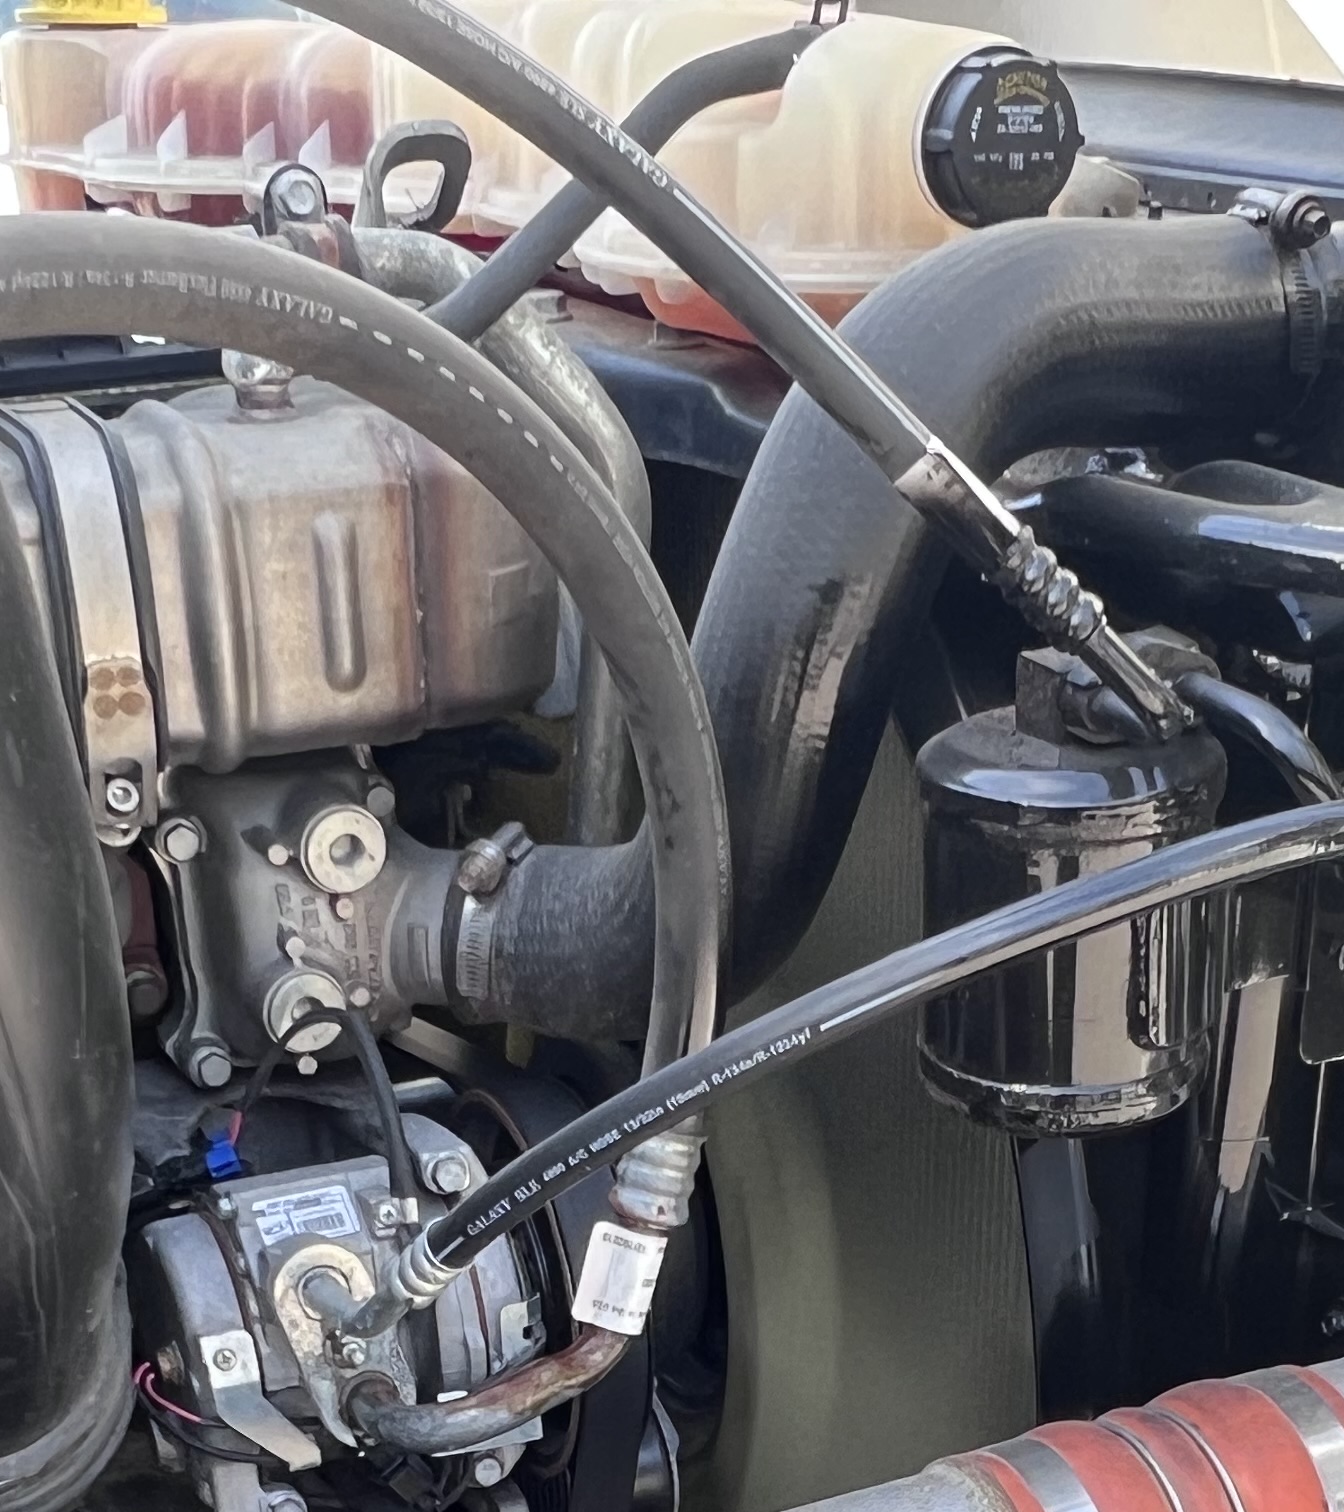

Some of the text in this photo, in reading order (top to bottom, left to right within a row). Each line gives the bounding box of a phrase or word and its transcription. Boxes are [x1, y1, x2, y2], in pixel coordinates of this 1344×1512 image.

[589, 112, 668, 188] GALAXY
[254, 286, 334, 323] GALAXY
[467, 1196, 513, 1236] GALAXY
